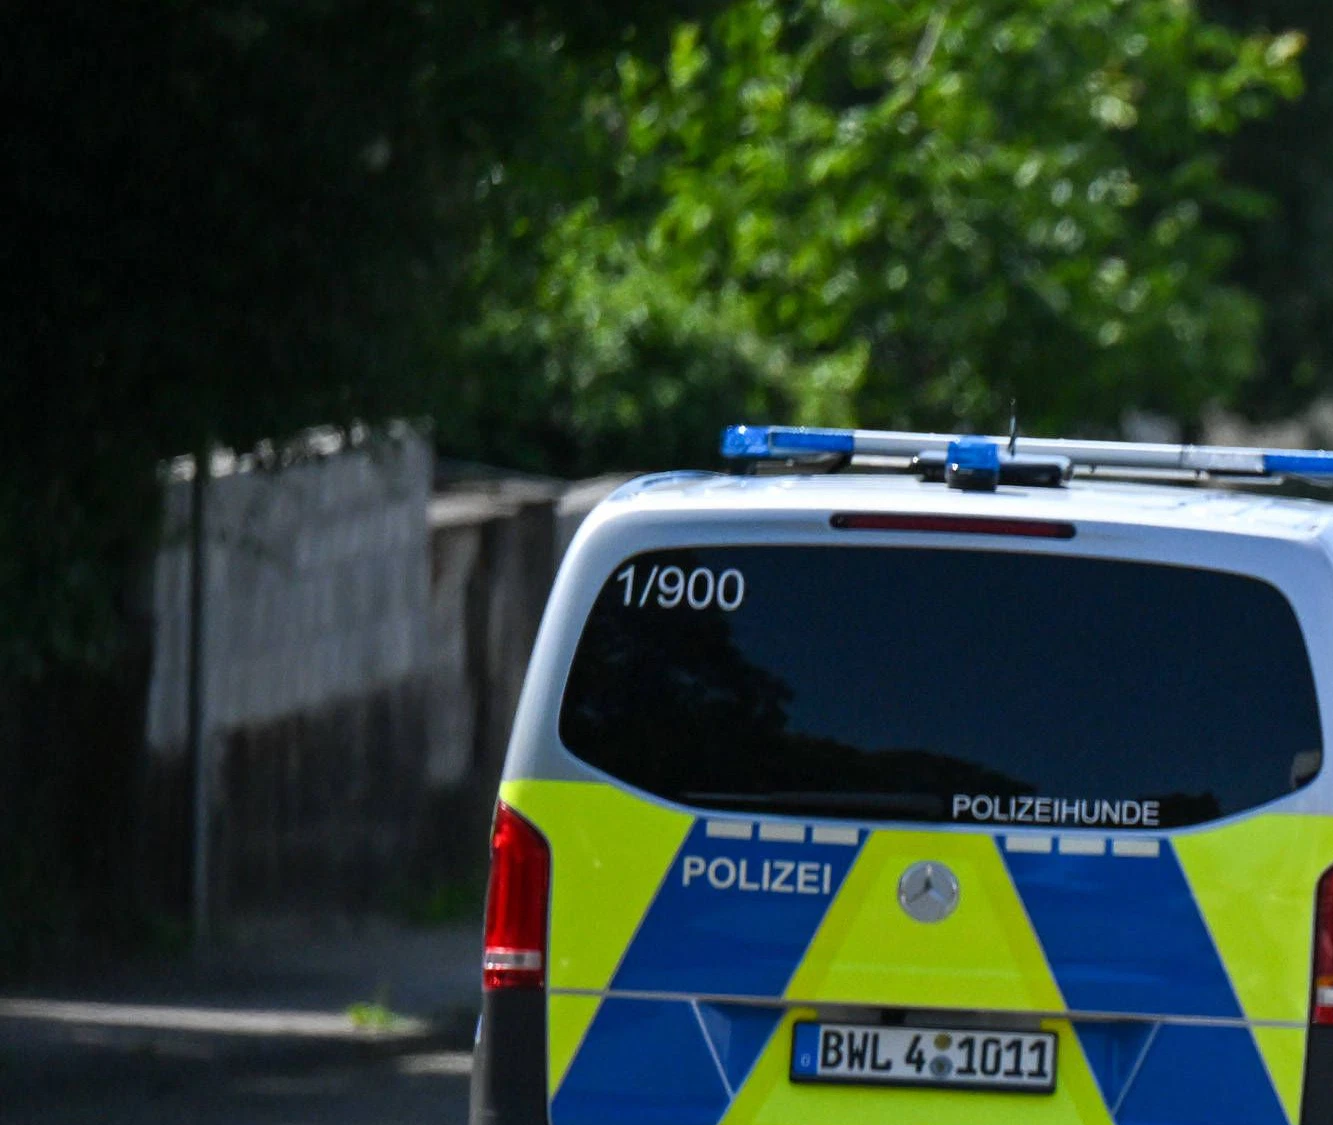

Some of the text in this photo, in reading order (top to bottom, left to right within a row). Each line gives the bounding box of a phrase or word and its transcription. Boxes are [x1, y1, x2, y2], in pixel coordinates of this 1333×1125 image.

[616, 563, 746, 612] 1/900
[951, 793, 1161, 827] POLIZEIHUNDE
[681, 855, 832, 896] POLIZEI
[819, 1029, 1049, 1079] BWL 4 1011
